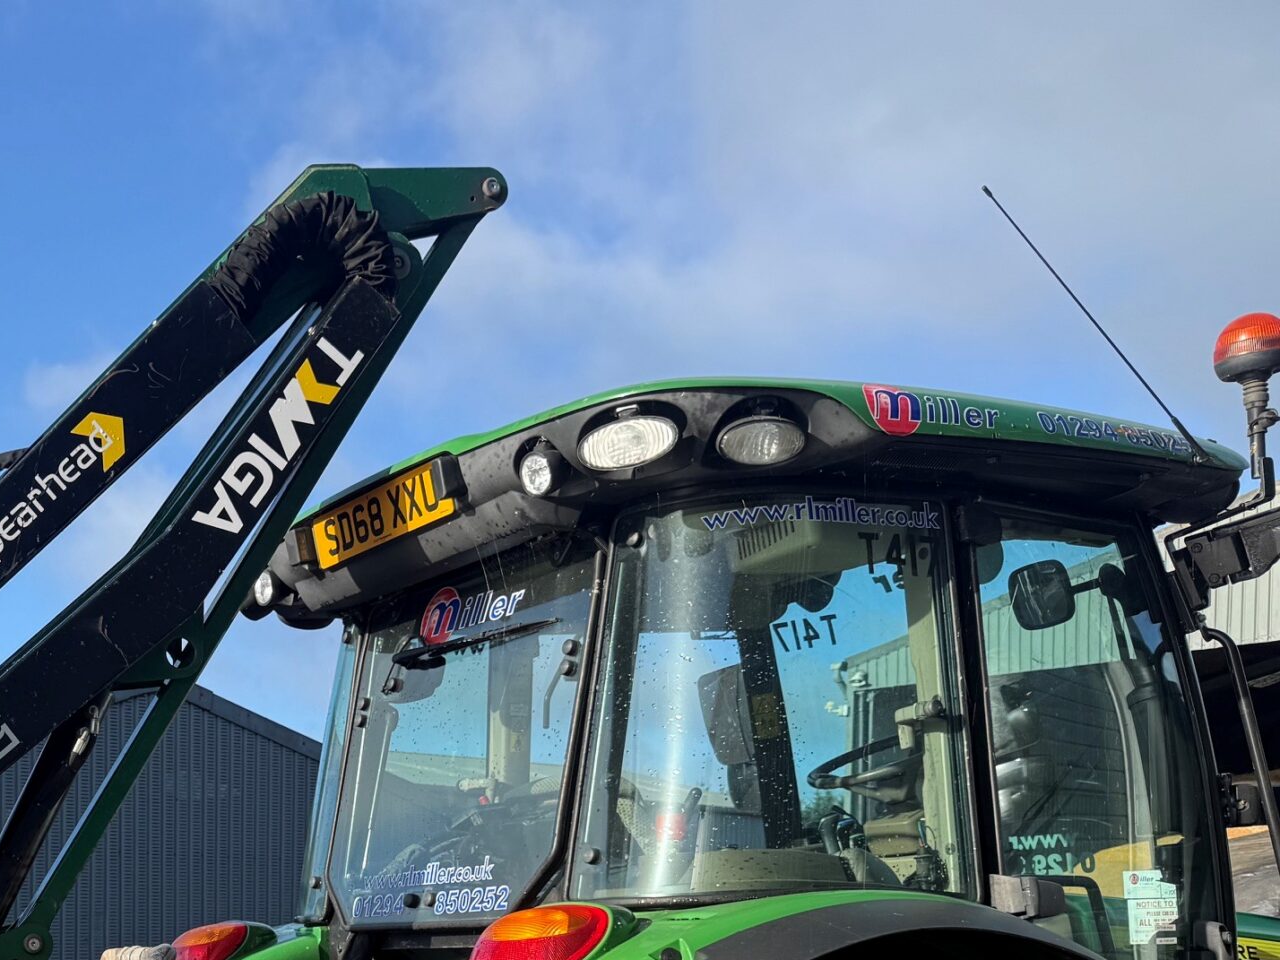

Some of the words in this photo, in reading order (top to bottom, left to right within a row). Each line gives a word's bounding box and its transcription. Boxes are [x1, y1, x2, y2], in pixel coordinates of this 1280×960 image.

[191, 337, 365, 534] TWIGA
[1036, 411, 1120, 442] 01294
[1120, 424, 1194, 454] 85025
[324, 496, 385, 557] SD68
[700, 496, 941, 531] www.rlmiller.co.uk
[364, 855, 495, 890] www.rlmiller.co.uk
[352, 893, 405, 918] 01294
[433, 885, 510, 915] 850252
